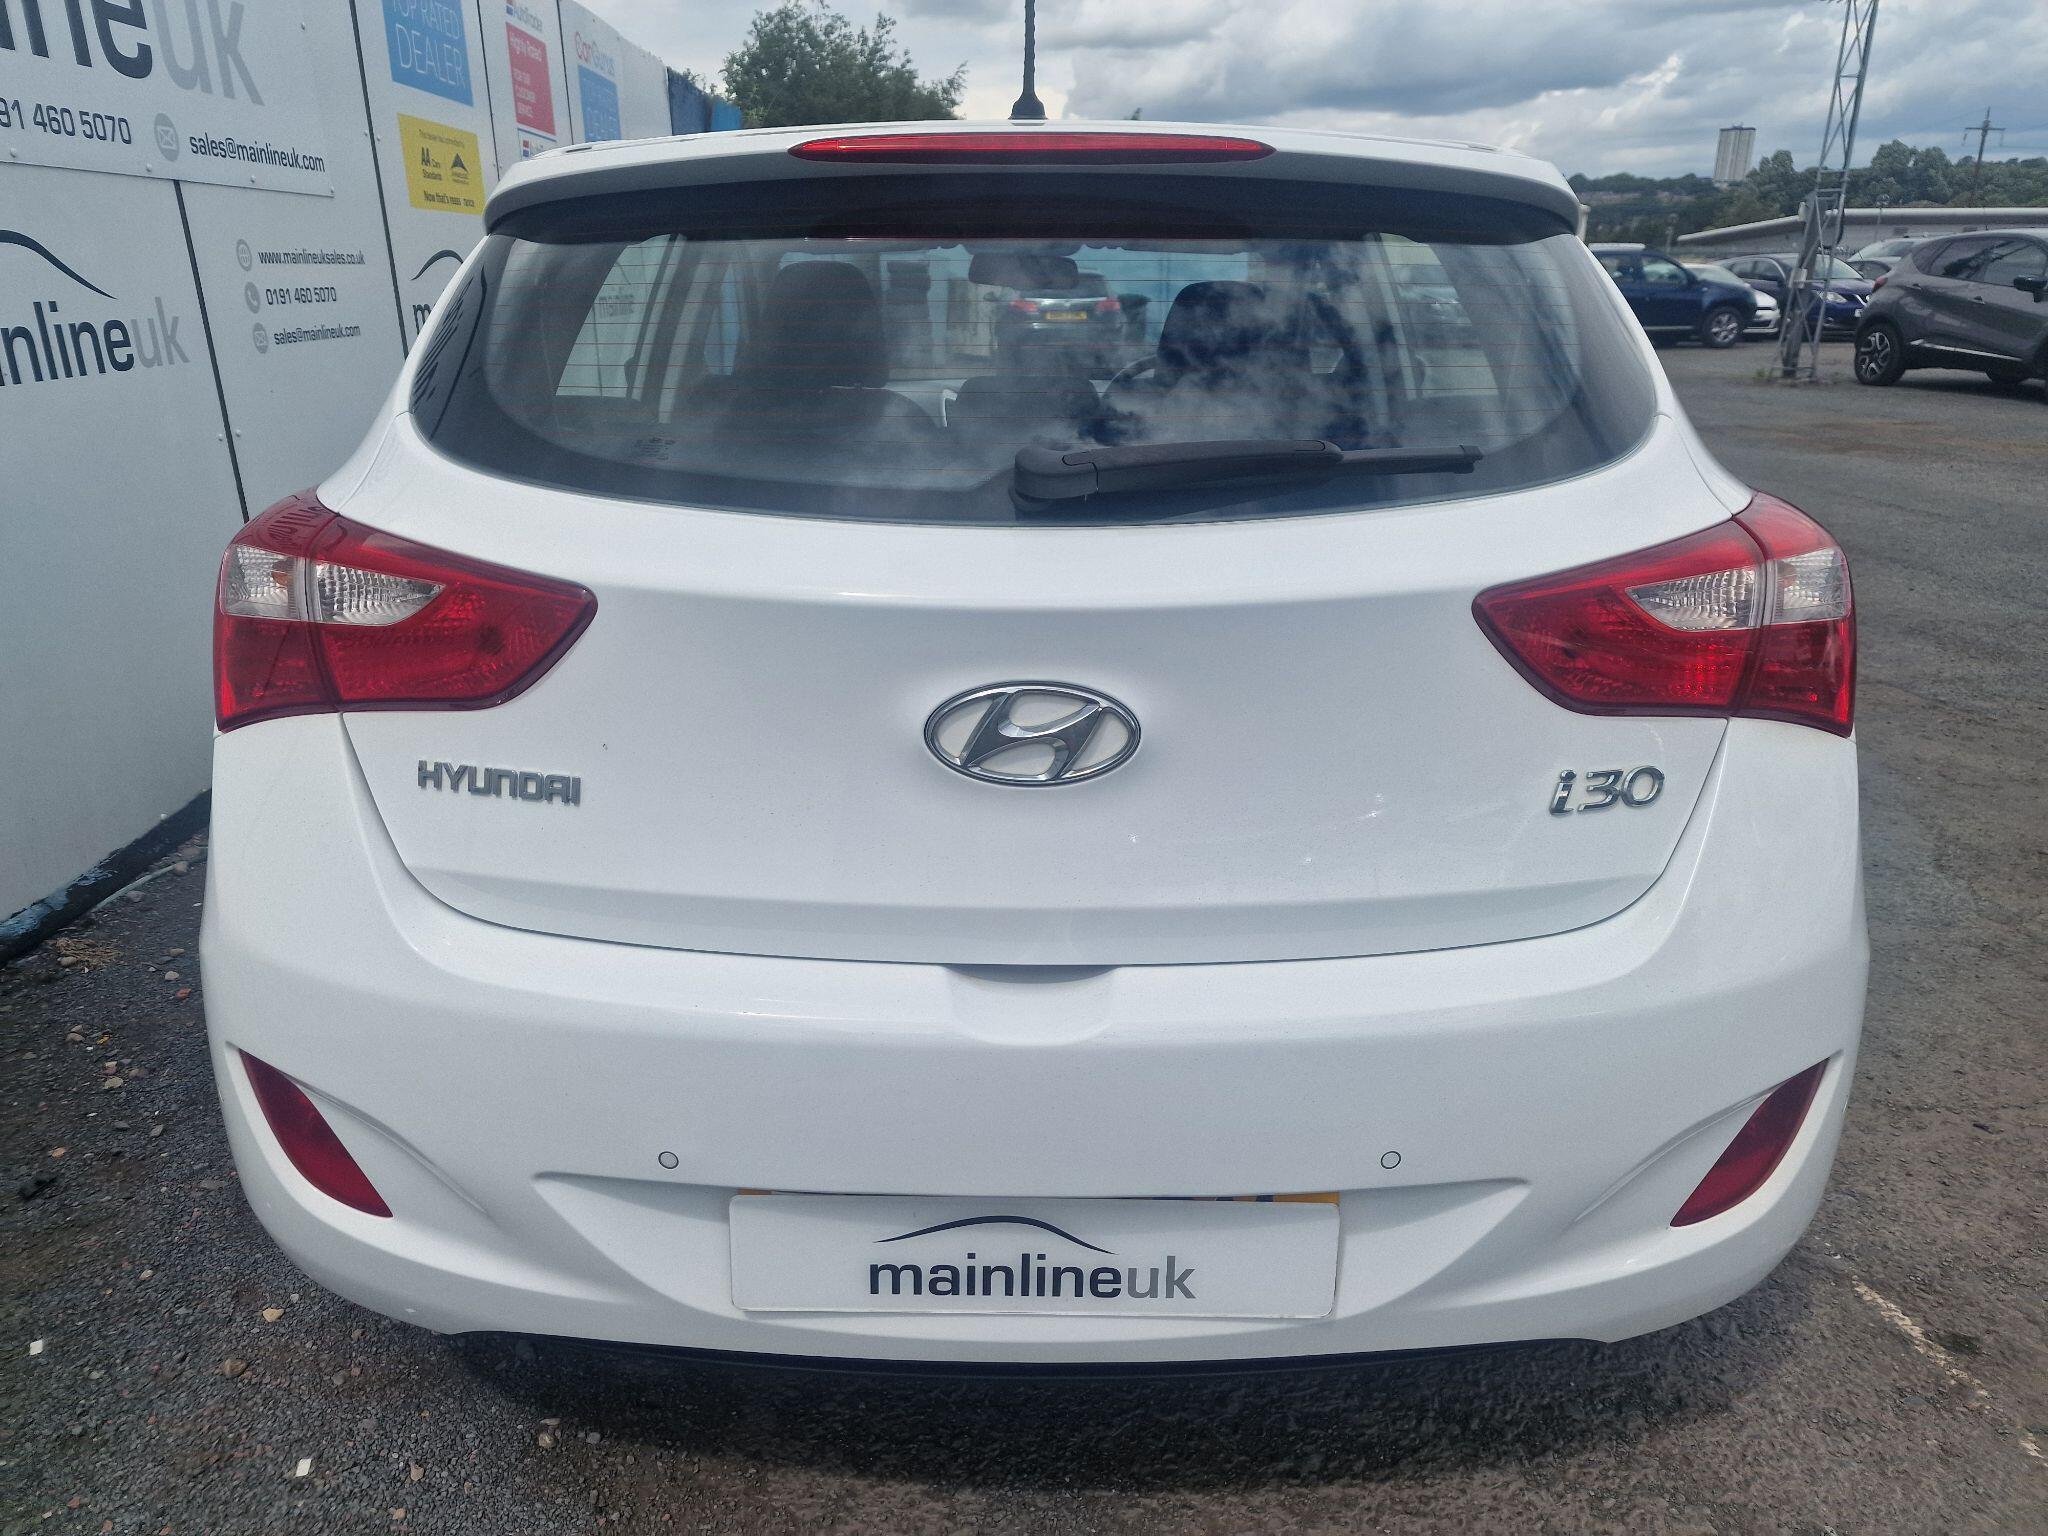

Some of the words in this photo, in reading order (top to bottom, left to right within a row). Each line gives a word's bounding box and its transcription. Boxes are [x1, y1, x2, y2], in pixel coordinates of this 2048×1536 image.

[395, 23, 466, 88] DEALER
[32, 103, 76, 137] 460
[78, 110, 132, 145] 5070
[189, 132, 326, 173] sales@mainlineuk.com
[258, 248, 365, 265] www.mainlineuksales.co.uk
[265, 288, 292, 305] 0191
[294, 287, 313, 304] 460
[314, 286, 338, 303] 5070
[0, 296, 191, 386] nlineuk
[274, 324, 361, 345] sales@mainlineuk.com
[417, 760, 582, 806] HYUNDAI
[1549, 764, 1666, 816] i30
[867, 1252, 1198, 1301] mainlineuk
